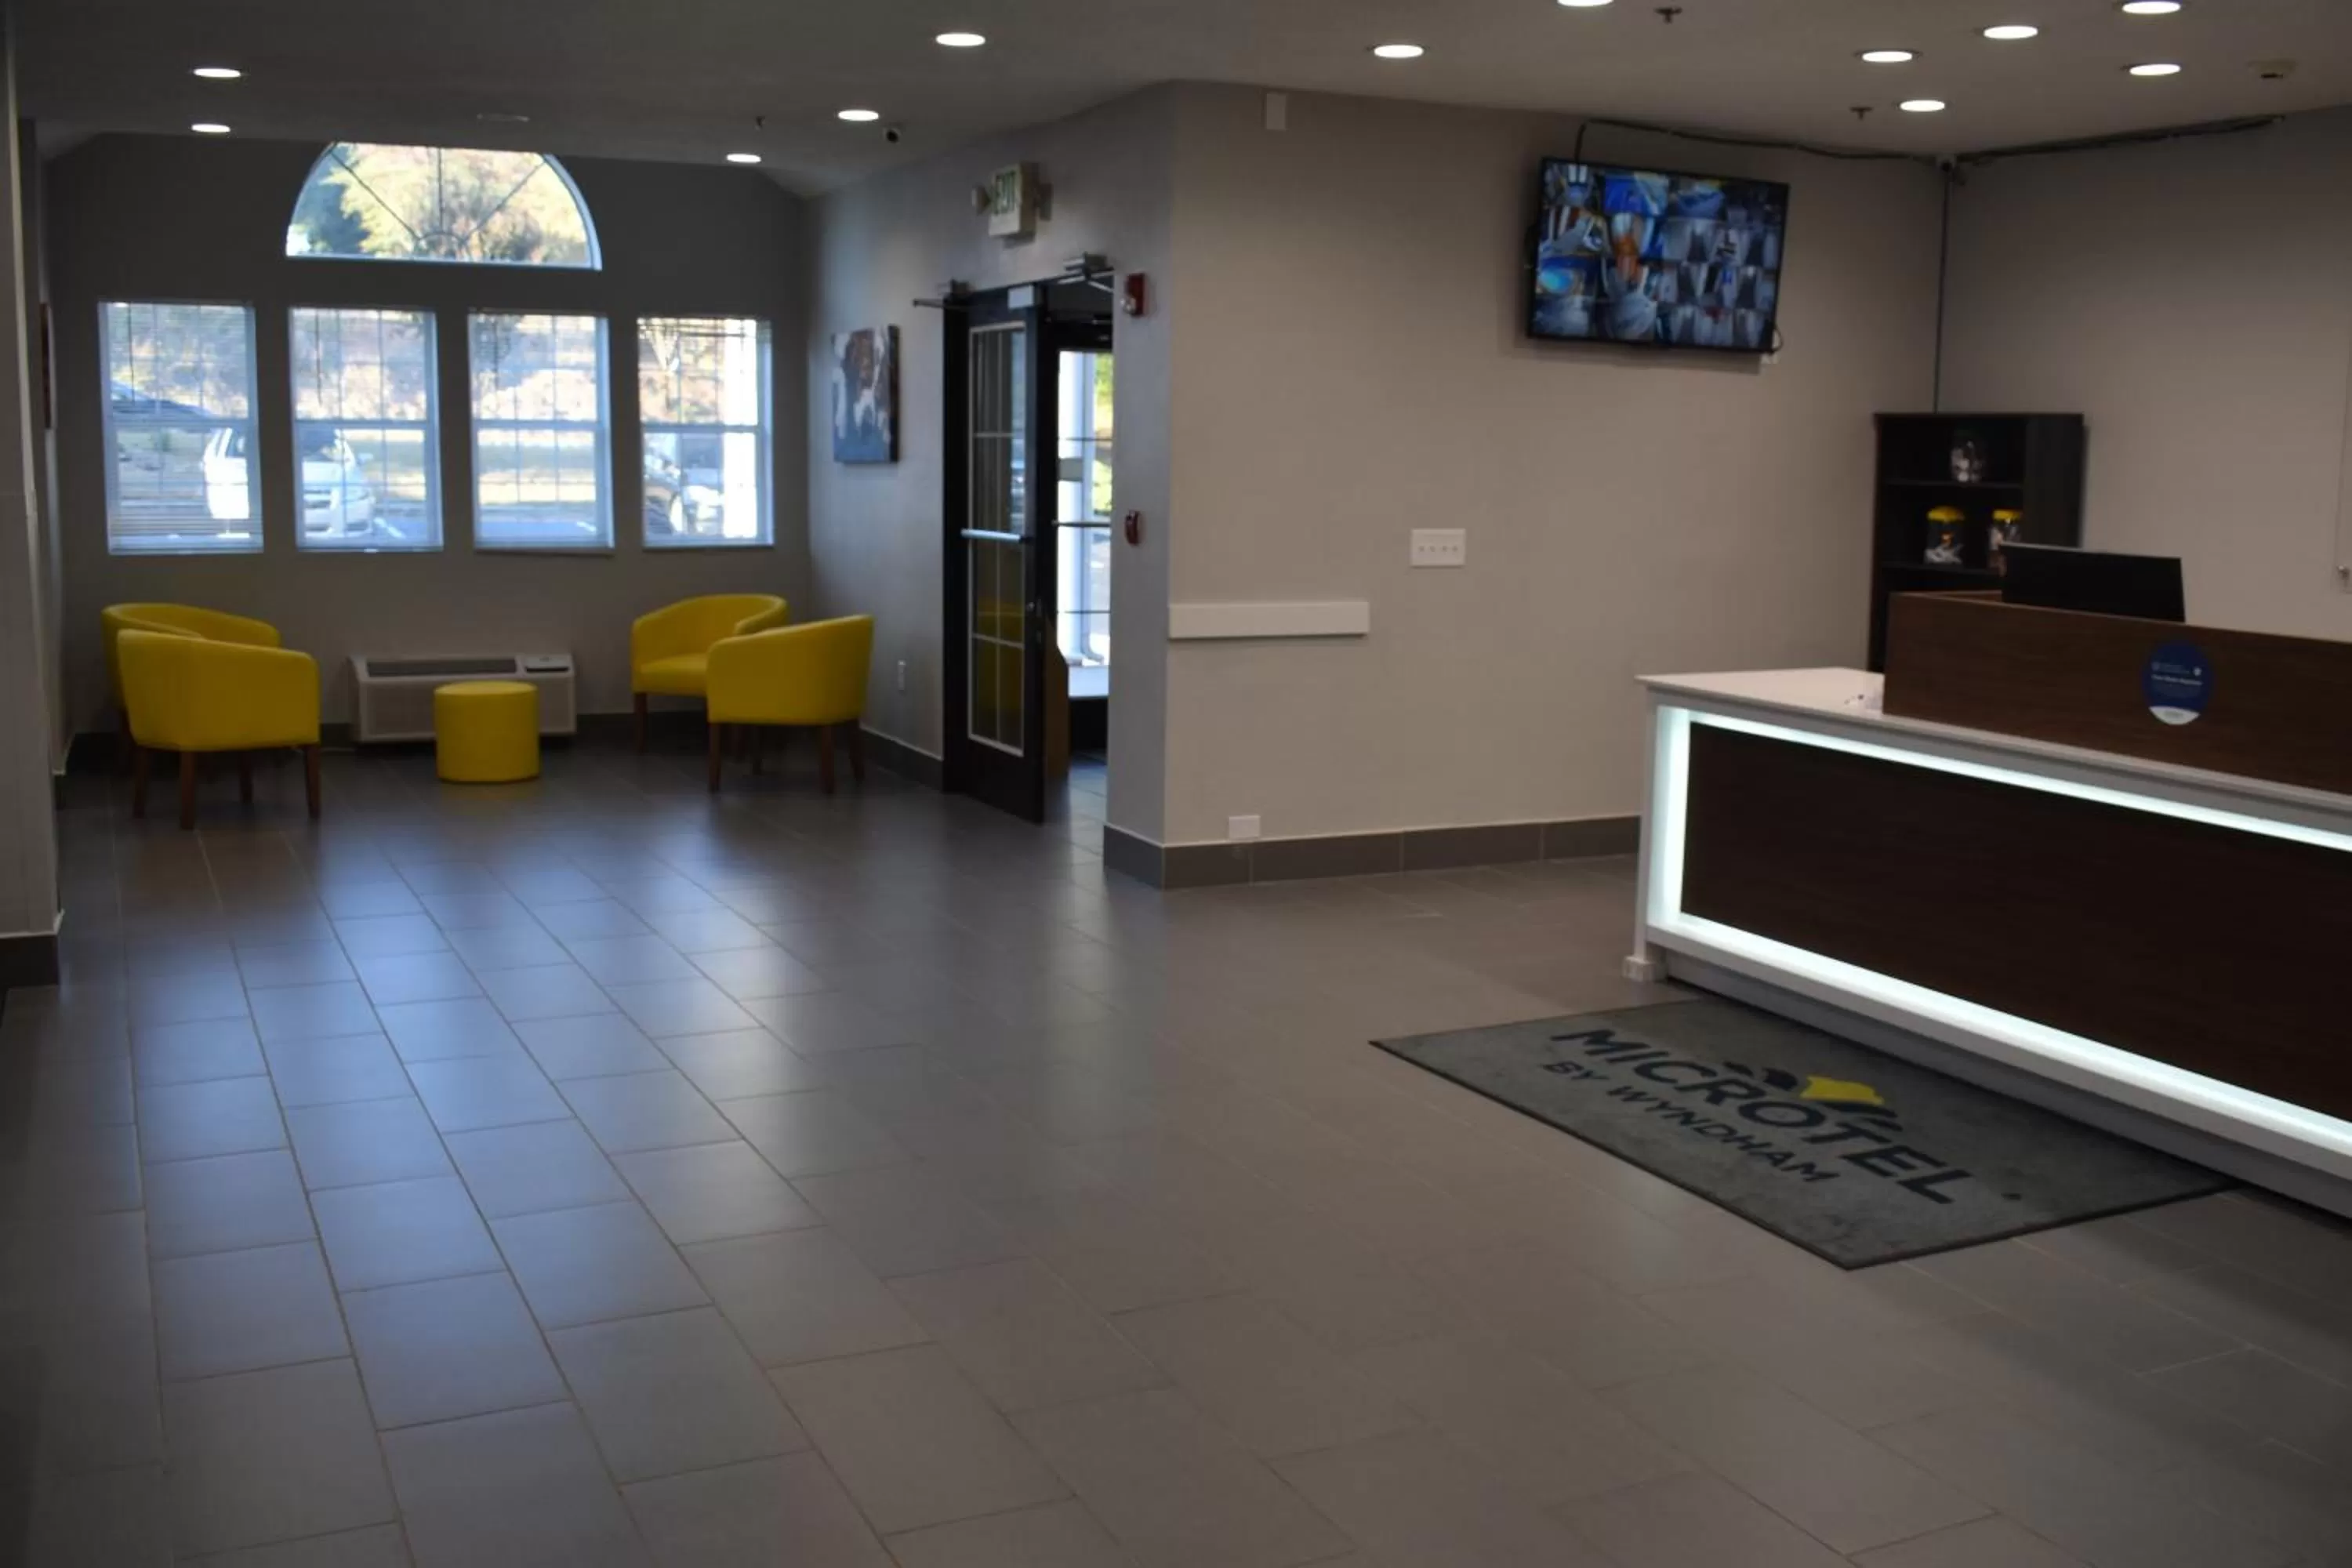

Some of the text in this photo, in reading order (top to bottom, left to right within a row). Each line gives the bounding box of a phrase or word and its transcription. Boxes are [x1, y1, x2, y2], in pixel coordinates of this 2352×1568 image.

[1542, 1061, 1841, 1181] BY WYNDHAM
[1549, 1029, 1972, 1204] MICROTEL
